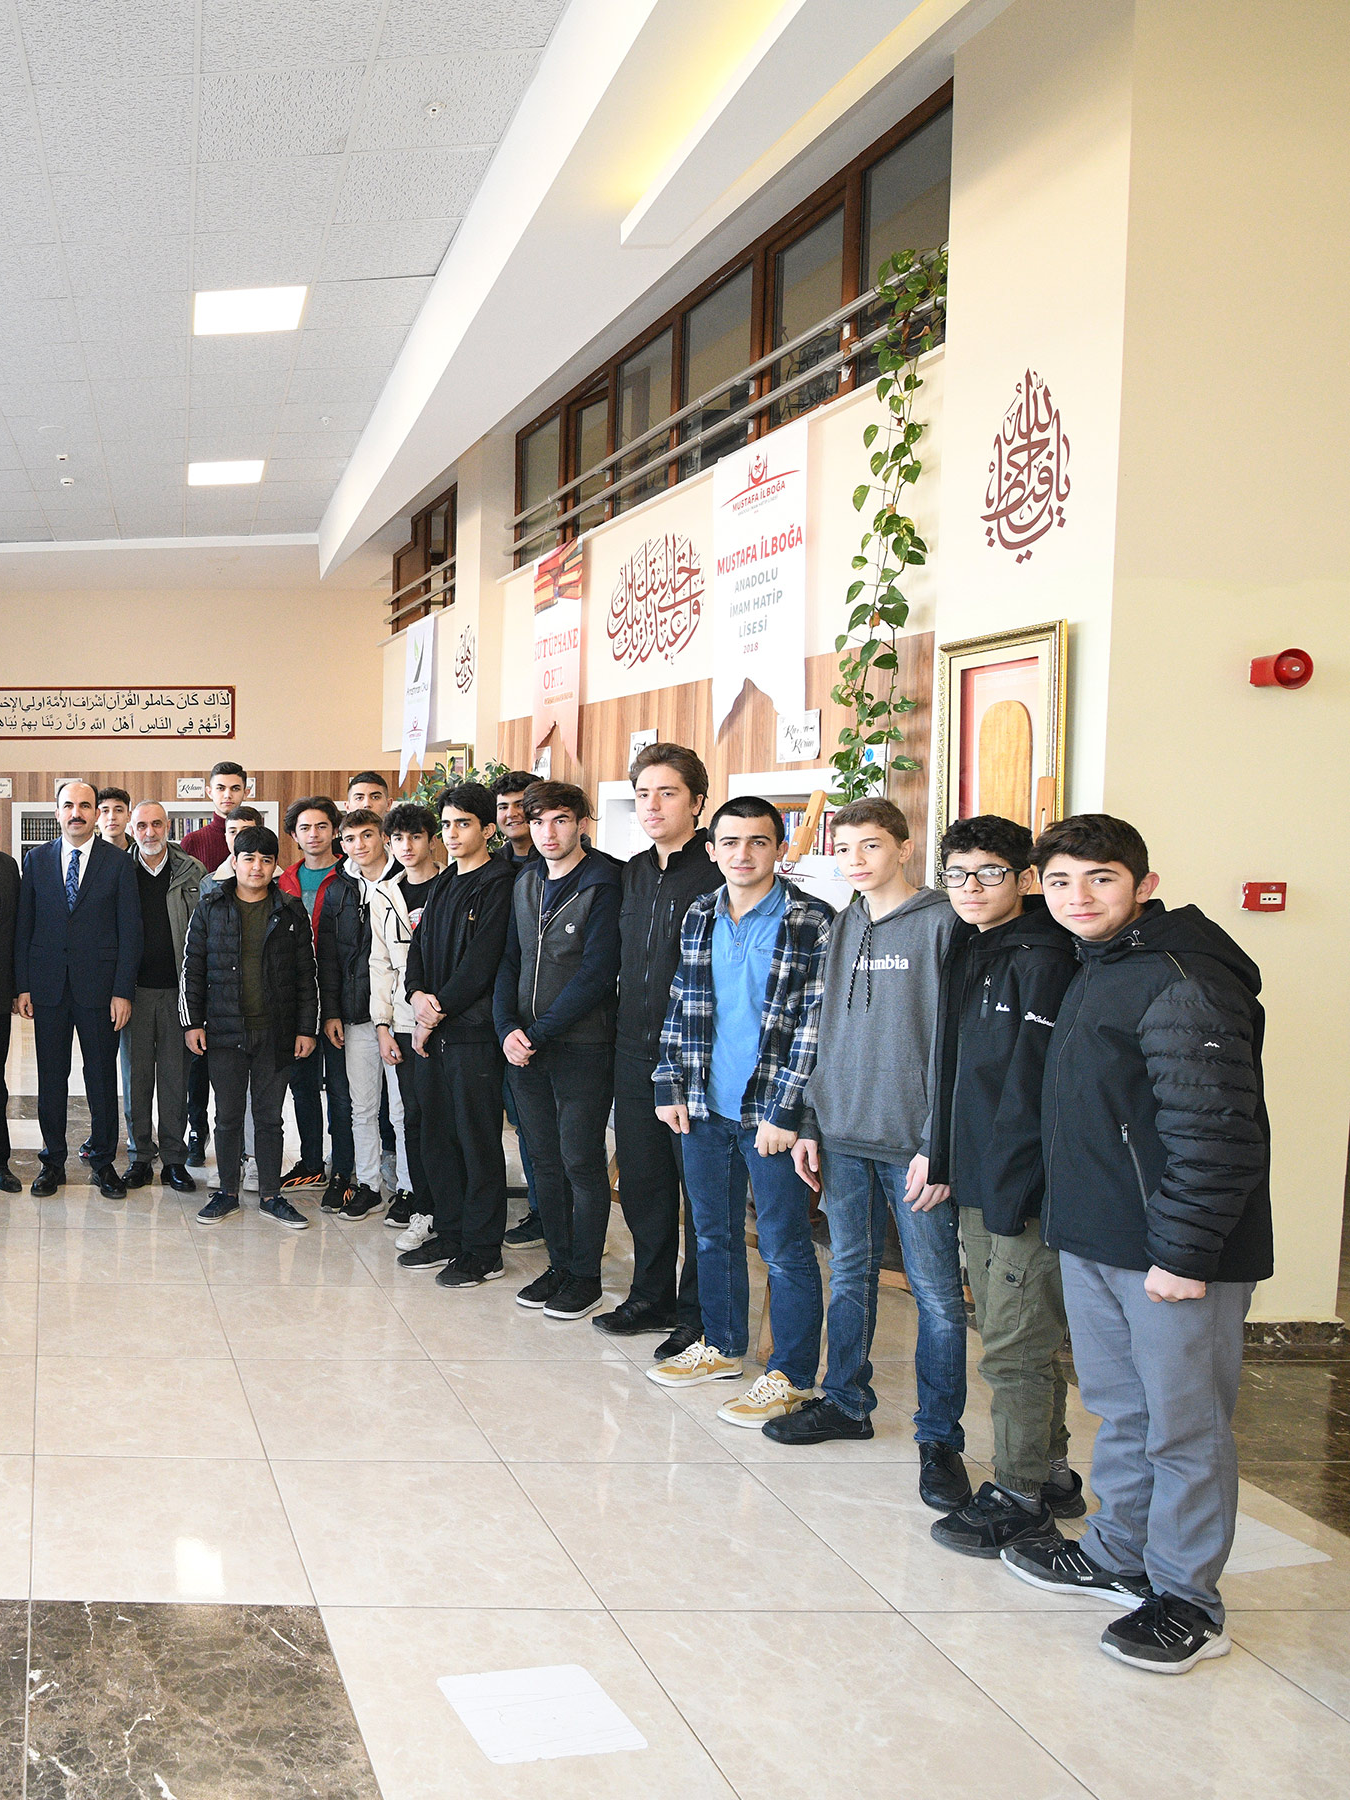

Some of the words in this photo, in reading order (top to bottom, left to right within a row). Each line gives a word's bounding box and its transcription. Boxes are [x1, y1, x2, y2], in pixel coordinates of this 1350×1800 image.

[732, 493, 759, 512] MUSTAFA
[760, 480, 786, 500] İLBOĞA
[717, 543, 757, 577] MUSTAFA
[760, 523, 803, 560] İLBOĞA
[734, 567, 779, 594] ANADOLU
[729, 600, 751, 618] İMAM
[753, 588, 783, 611] HATİP
[738, 615, 768, 638] LİSESİ
[743, 642, 759, 654] 2018
[852, 954, 909, 970] olumbia
